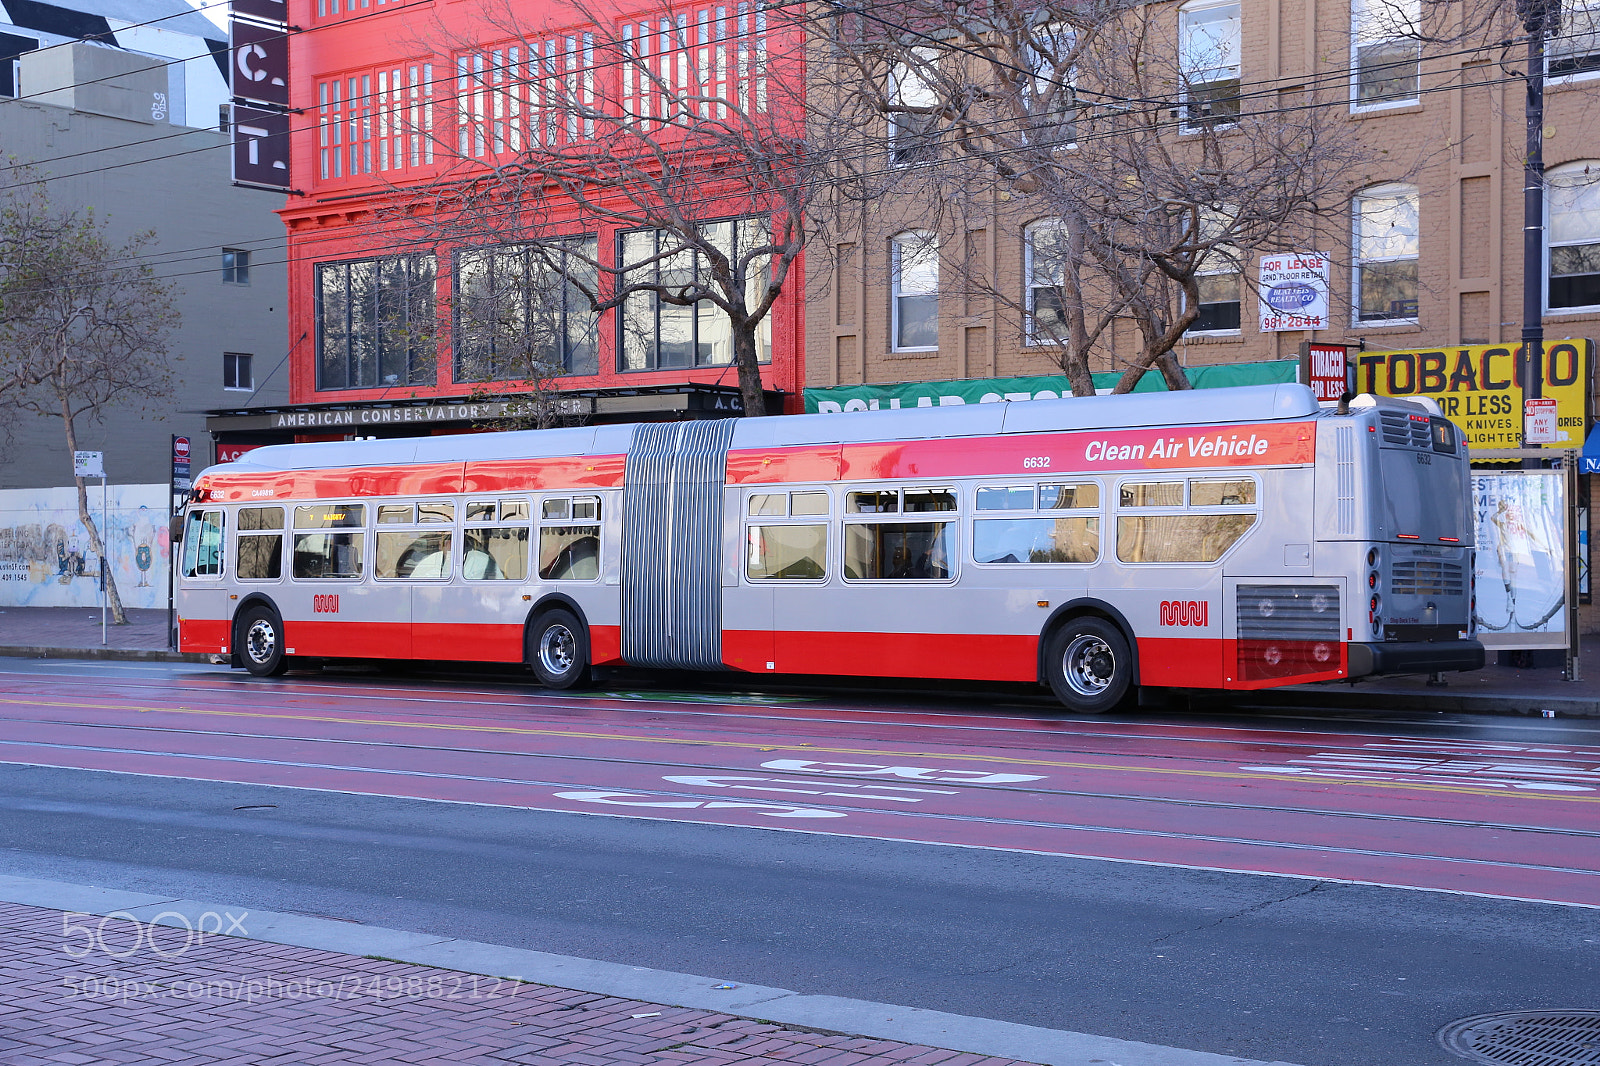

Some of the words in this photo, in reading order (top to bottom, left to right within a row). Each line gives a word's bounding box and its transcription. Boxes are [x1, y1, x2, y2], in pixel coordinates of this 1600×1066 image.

[1263, 261, 1282, 272] FOR
[1288, 259, 1323, 270] LEASE
[1270, 295, 1300, 303] REALTY
[1301, 294, 1314, 302] CO
[1264, 315, 1321, 329] 981-2844
[1310, 350, 1344, 378] TOBACCO
[1310, 380, 1325, 398] FOR
[1326, 380, 1345, 398] LESS
[1436, 396, 1461, 417] OR
[1465, 394, 1512, 416] LESS
[278, 411, 353, 427] AMERICAN
[361, 404, 490, 424] CONSERVATORY
[1534, 418, 1549, 426] ANY
[1558, 416, 1583, 427] ORIES
[1533, 426, 1549, 434] TIME
[1085, 440, 1145, 462] Clean
[1147, 437, 1184, 459] Air
[1187, 434, 1269, 458] Vehicle
[1023, 456, 1051, 468] 6632
[1416, 452, 1432, 466] 6632
[210, 490, 225, 499] 6632
